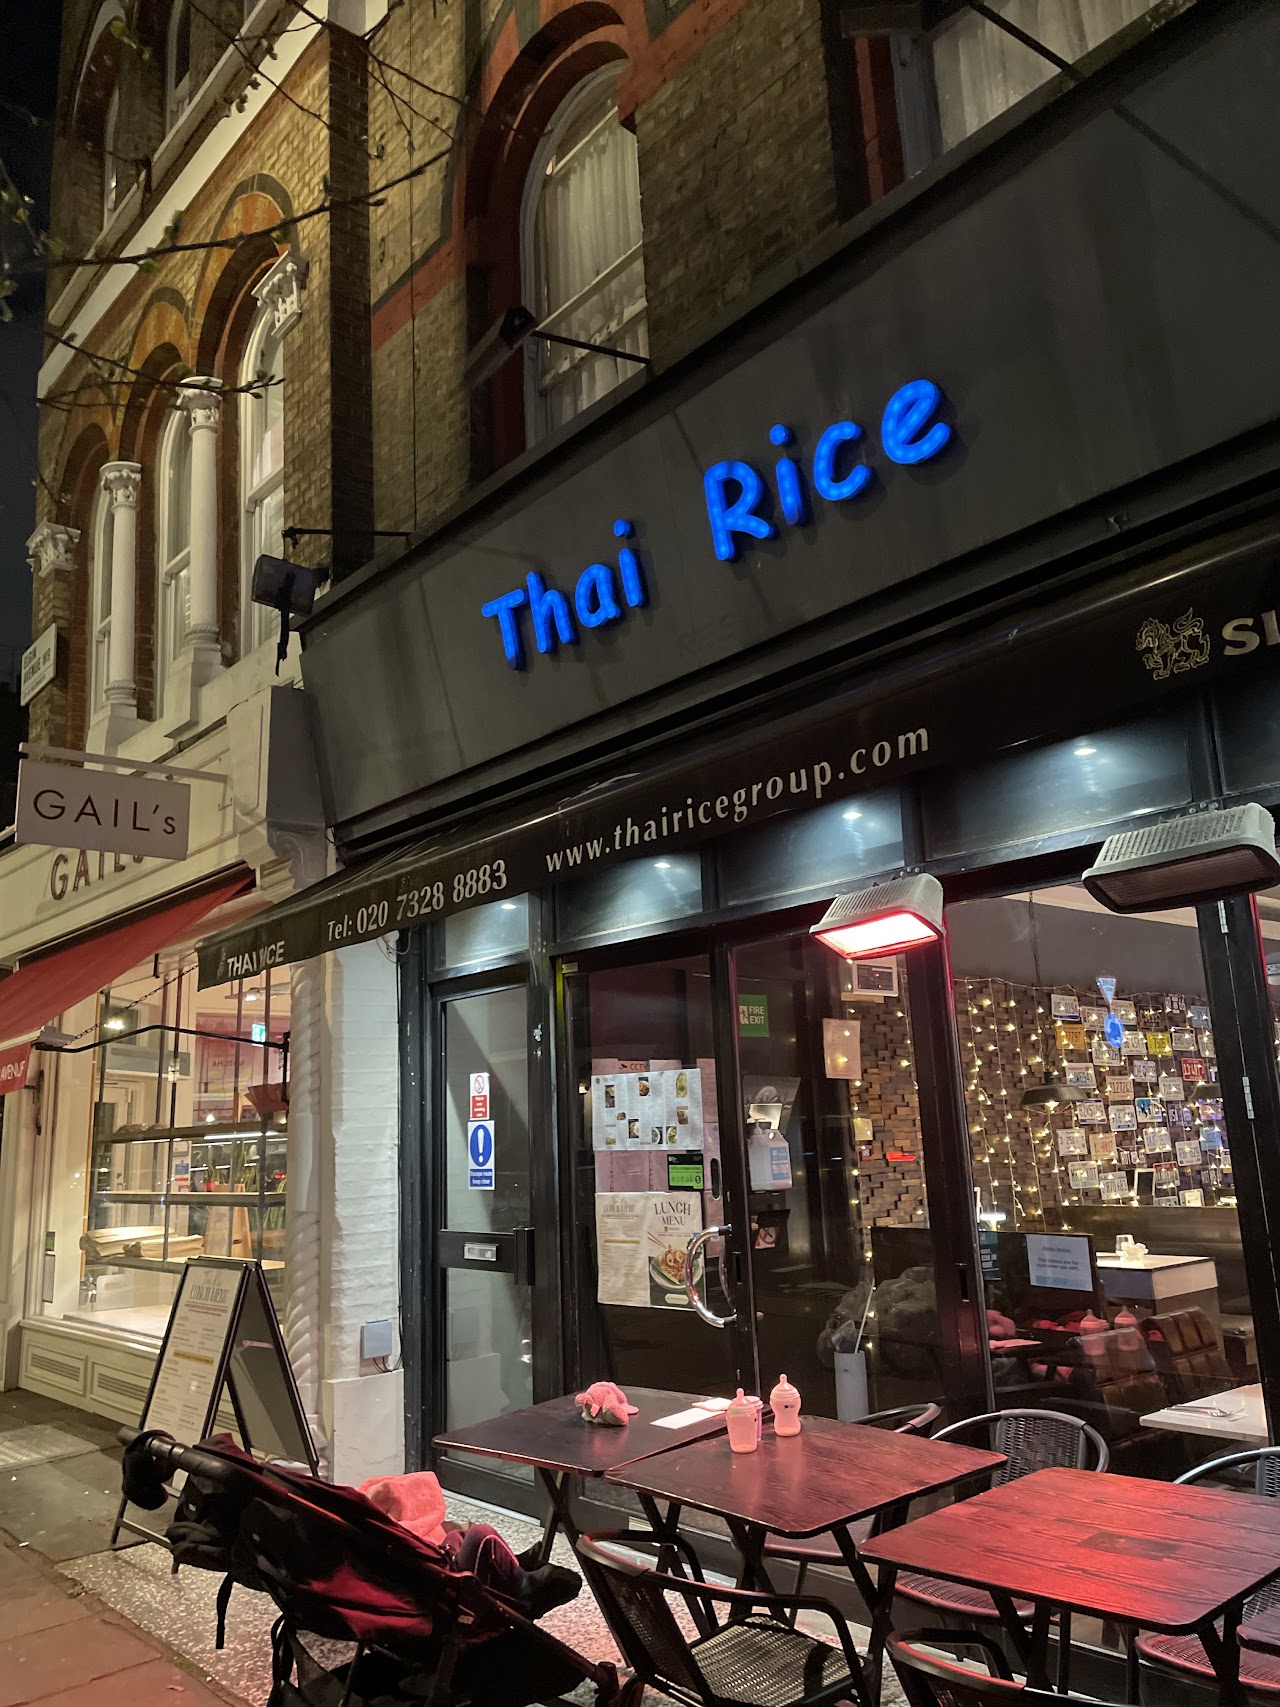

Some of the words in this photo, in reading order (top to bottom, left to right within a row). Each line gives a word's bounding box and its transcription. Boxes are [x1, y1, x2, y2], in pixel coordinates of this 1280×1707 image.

[482, 518, 648, 671] Thai
[704, 378, 951, 562] Rice
[546, 727, 929, 873] www.thairicegroup.com
[33, 789, 176, 835] GAIL's
[327, 915, 352, 942] Tel:
[357, 900, 389, 934] 020
[396, 881, 444, 921] 7328
[453, 859, 507, 903] 8883
[227, 951, 257, 978] THAI
[749, 1006, 765, 1015] FIRE
[750, 1016, 765, 1024] EXIT
[630, 1063, 648, 1071] CCTV
[654, 1201, 691, 1216] LUNCH
[662, 1215, 687, 1226] MENU
